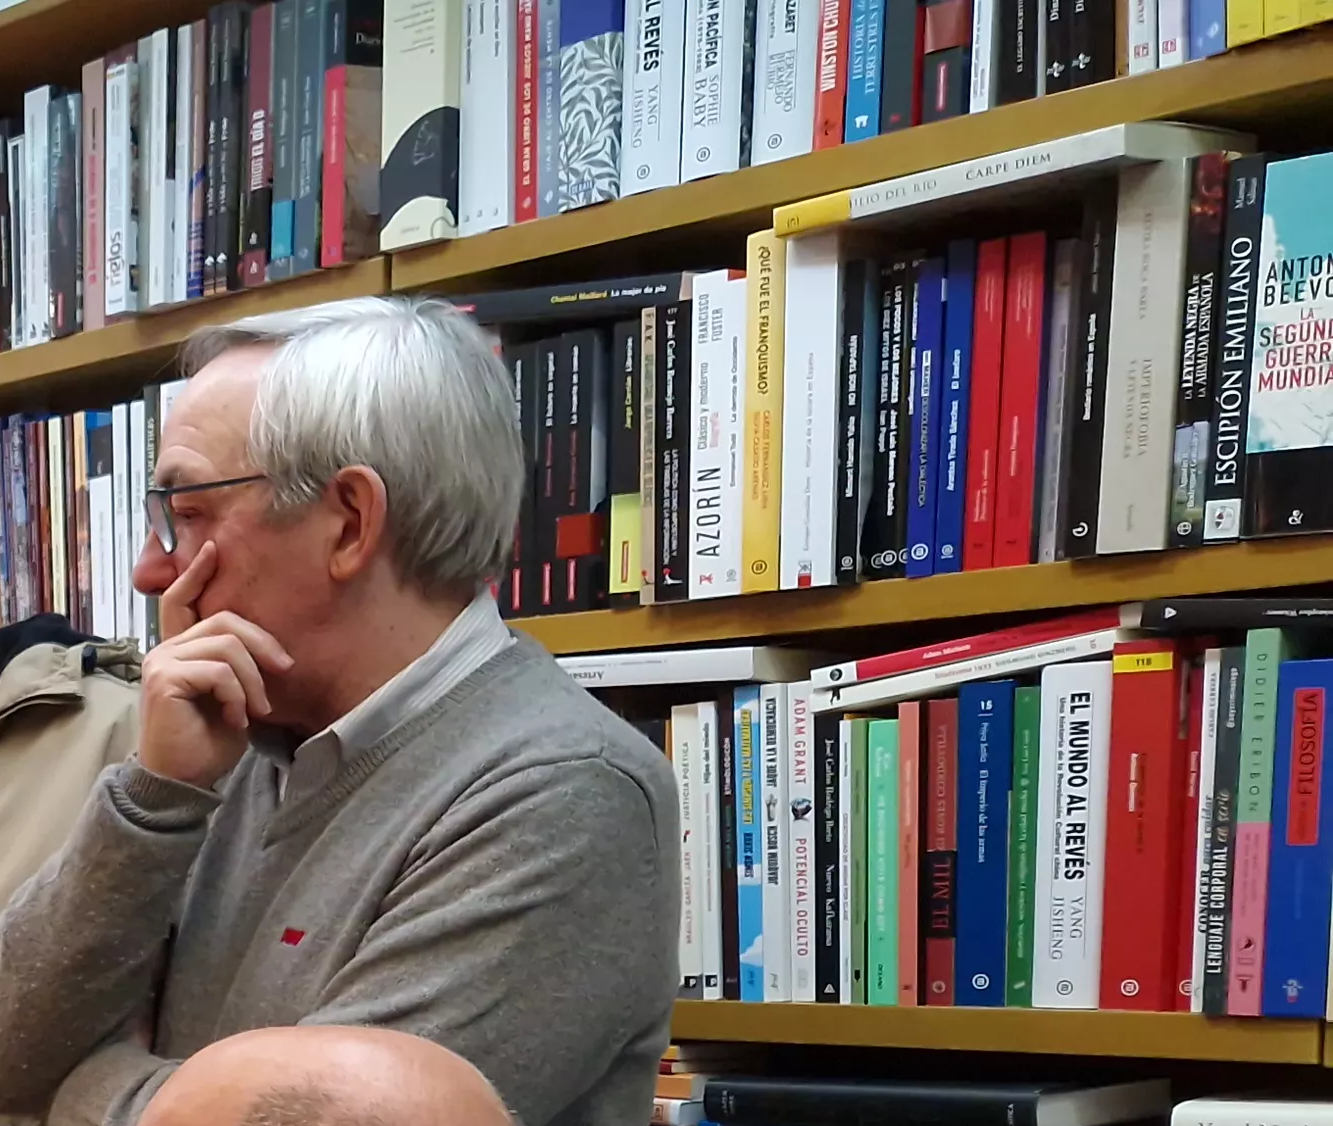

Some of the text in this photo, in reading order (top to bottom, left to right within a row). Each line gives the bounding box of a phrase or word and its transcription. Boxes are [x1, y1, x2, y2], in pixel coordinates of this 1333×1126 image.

[642, 16, 664, 72] REVÉS
[704, 14, 723, 69] PACÍFICA
[820, 30, 838, 92] WINSTON
[864, 12, 879, 94] TERRESTRES
[633, 84, 660, 149] YANG JISHENG
[693, 74, 720, 129] SOPHIE BABY
[885, 188, 907, 201] DEL
[965, 162, 1010, 182] CARPE
[1014, 151, 1052, 171] DIEM
[697, 293, 723, 345] FRANCISCO FUSTER
[755, 244, 773, 395] ¿QUÉ FUE EL FRANQUISMO?
[1184, 286, 1201, 329] NEGRA
[1195, 272, 1214, 398] LA ARMADA ESPAÑOLA
[1299, 307, 1315, 321] LA
[698, 361, 710, 404] moderno
[1181, 331, 1197, 388] LEYENDA
[1212, 236, 1253, 485] ESCIPIÓN EMILIANO
[1136, 358, 1154, 458] IMPERIOFOBIA
[1184, 388, 1194, 400] LA
[697, 415, 709, 451] Clásico
[691, 466, 722, 558] AZORÍN
[980, 699, 993, 711] 15
[1058, 715, 1066, 748] historia
[794, 698, 807, 786] ADAM GRANT
[824, 738, 836, 757] José
[1057, 749, 1066, 761] de
[1247, 653, 1268, 813] DIDIER ERIBON
[1294, 692, 1319, 796] FILOSOFÍA
[766, 764, 778, 788] JAQUE
[824, 758, 835, 785] Carlos
[1055, 773, 1065, 819] Revolución
[1064, 692, 1091, 881] EL MUNDO AL REVÉS
[1053, 821, 1064, 855] Cultural
[824, 864, 835, 893] Nuevo
[932, 857, 951, 929] EL MIL
[1053, 856, 1062, 880] china
[1208, 846, 1228, 909] CORPORAL
[795, 838, 809, 957] POTENCIAL OCULTO
[1050, 895, 1084, 961] YANG JISHENG
[1206, 913, 1225, 973] LENGUAJE
